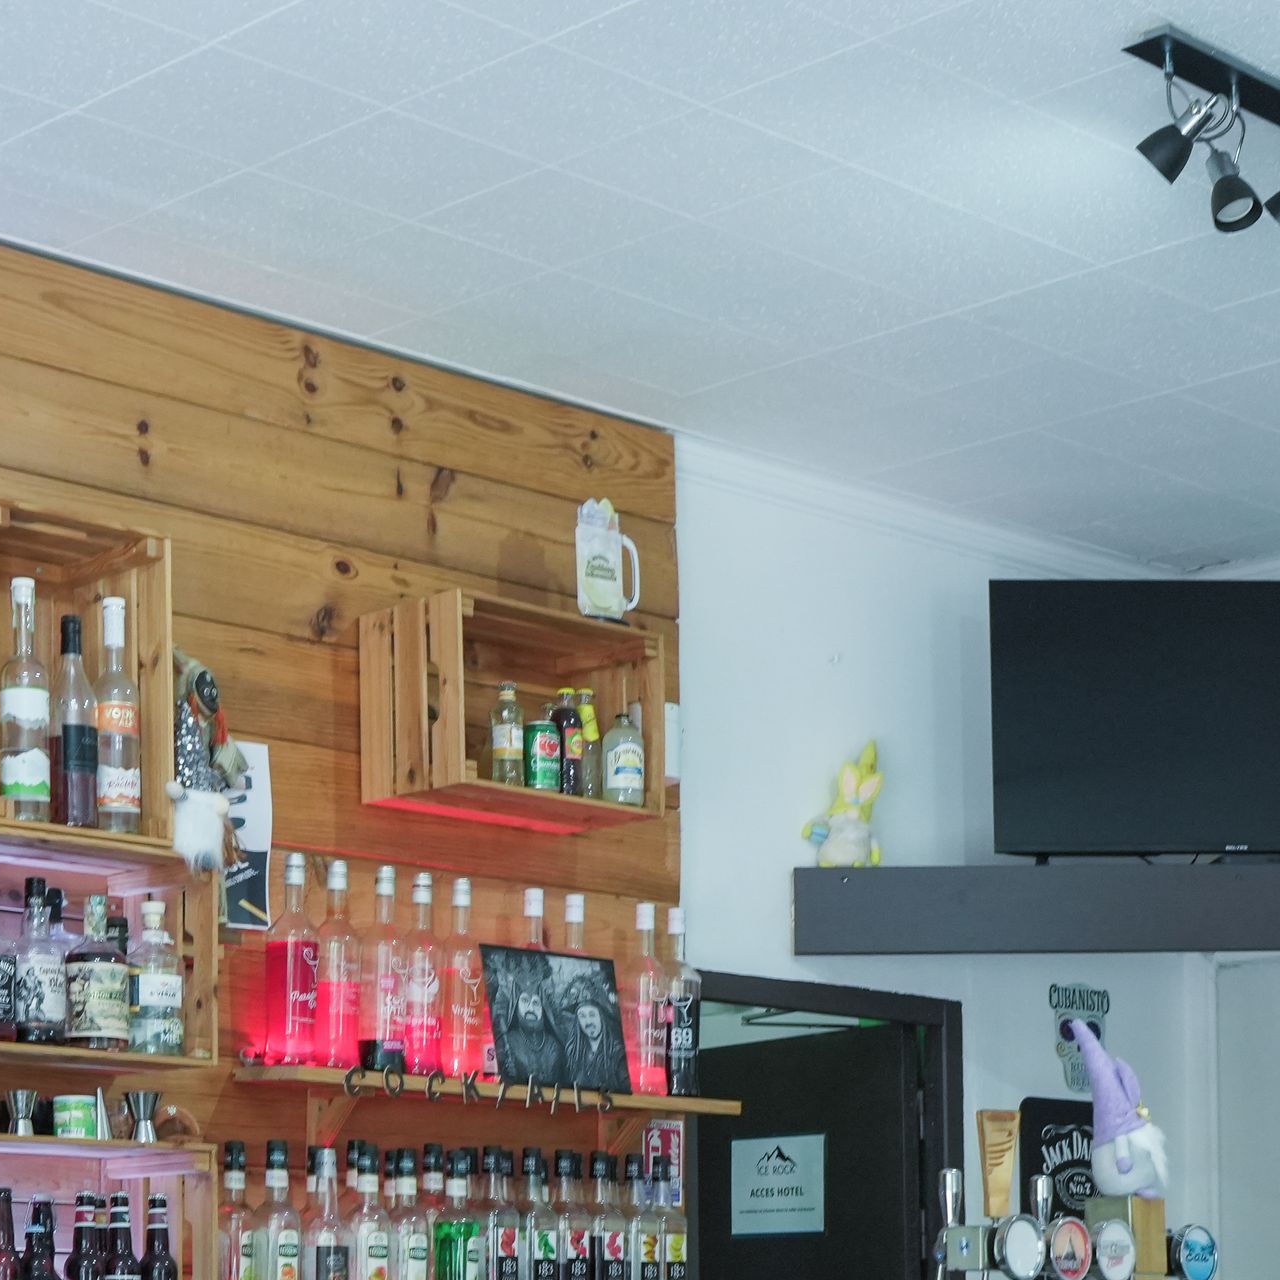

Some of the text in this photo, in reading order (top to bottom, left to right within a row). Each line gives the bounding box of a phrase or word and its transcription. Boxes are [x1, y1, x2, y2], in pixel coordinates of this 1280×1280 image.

[1048, 983, 1110, 1015] CUBANISTO
[343, 1064, 615, 1115] COCKTAILS
[772, 1164, 796, 1176] ROCK
[1041, 1138, 1072, 1175] JACK
[750, 1186, 804, 1199] ACCES HOTEL
